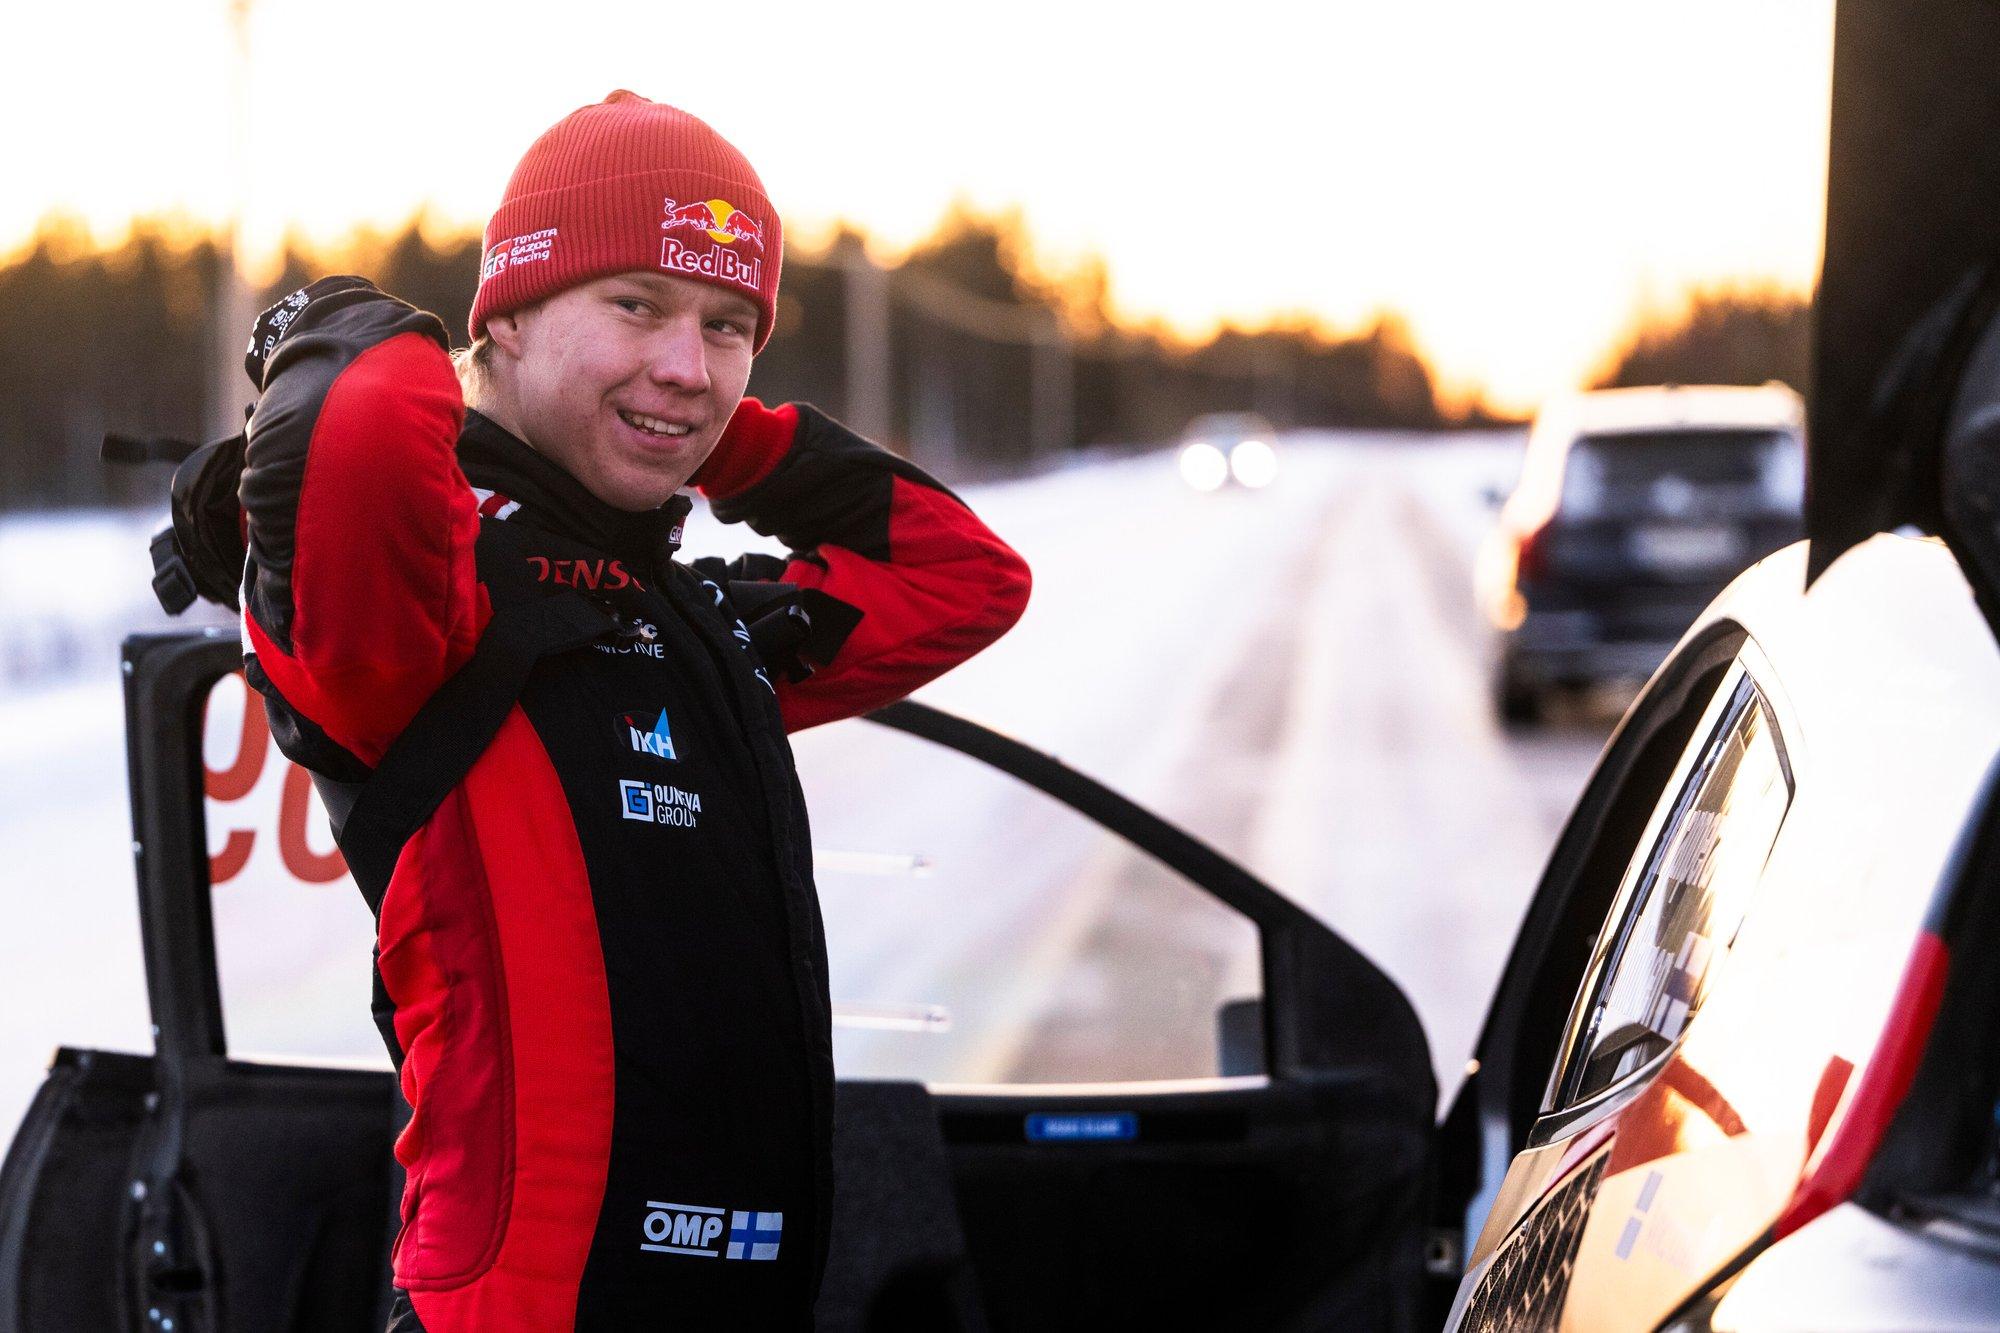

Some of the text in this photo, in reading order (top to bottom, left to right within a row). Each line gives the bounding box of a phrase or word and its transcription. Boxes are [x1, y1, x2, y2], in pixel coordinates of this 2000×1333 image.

[510, 239, 552, 256] GAZOO
[513, 227, 558, 246] TOYOTA
[484, 252, 509, 279] GR
[509, 250, 550, 267] Racing
[526, 555, 646, 593] DENS
[630, 726, 677, 760] IKH
[643, 1211, 724, 1247] OMP
